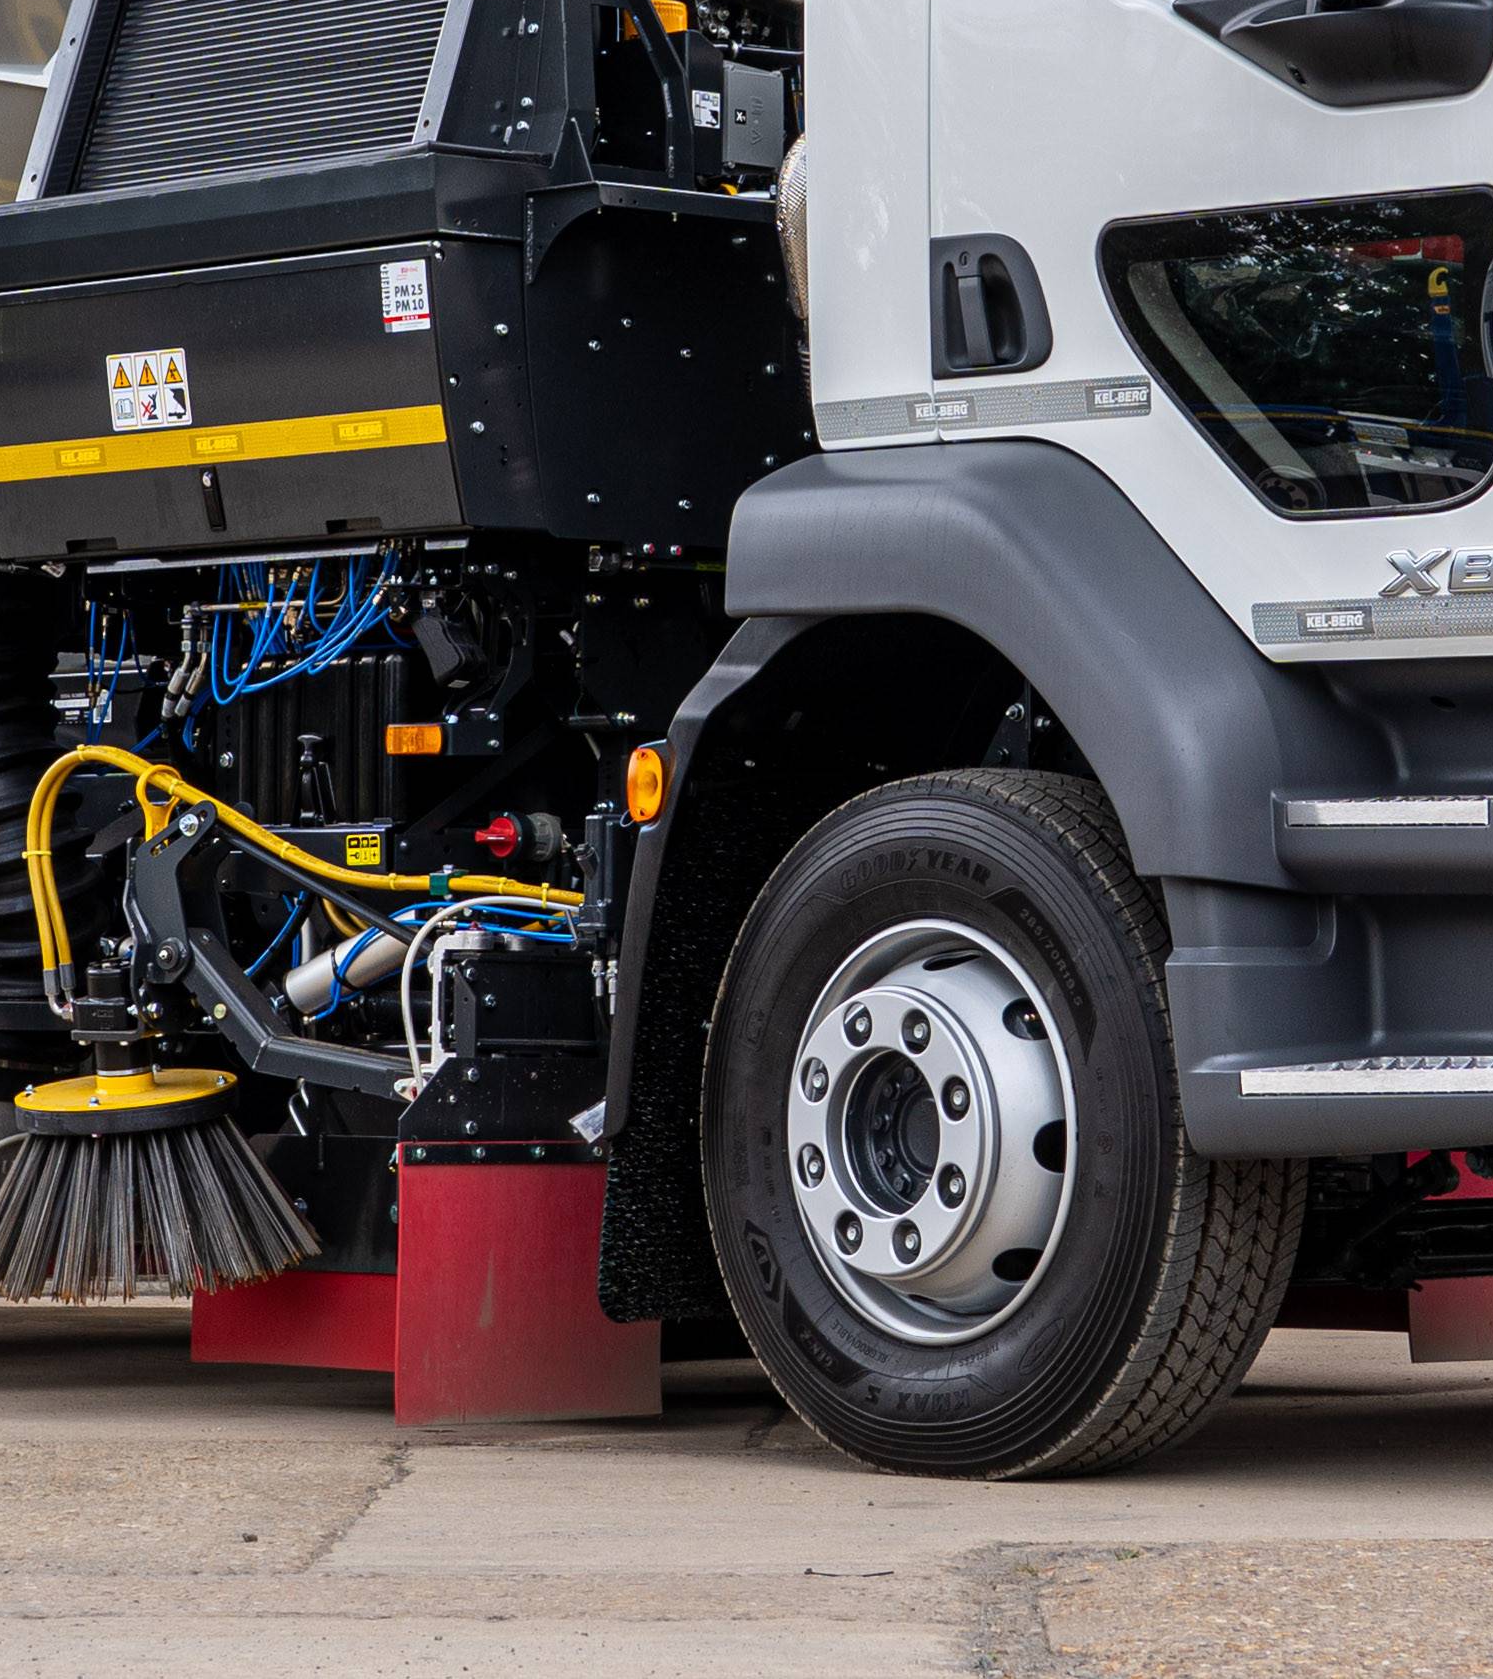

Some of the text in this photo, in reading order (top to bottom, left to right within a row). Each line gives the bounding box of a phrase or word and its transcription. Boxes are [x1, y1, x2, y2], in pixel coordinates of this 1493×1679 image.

[394, 285, 410, 298] PM
[395, 299, 424, 312] PM 10
[915, 388, 1148, 419] KEL-BERG KEL-BERG
[1306, 612, 1364, 628] KEL-BERG
[893, 1388, 971, 1411] KMAX
